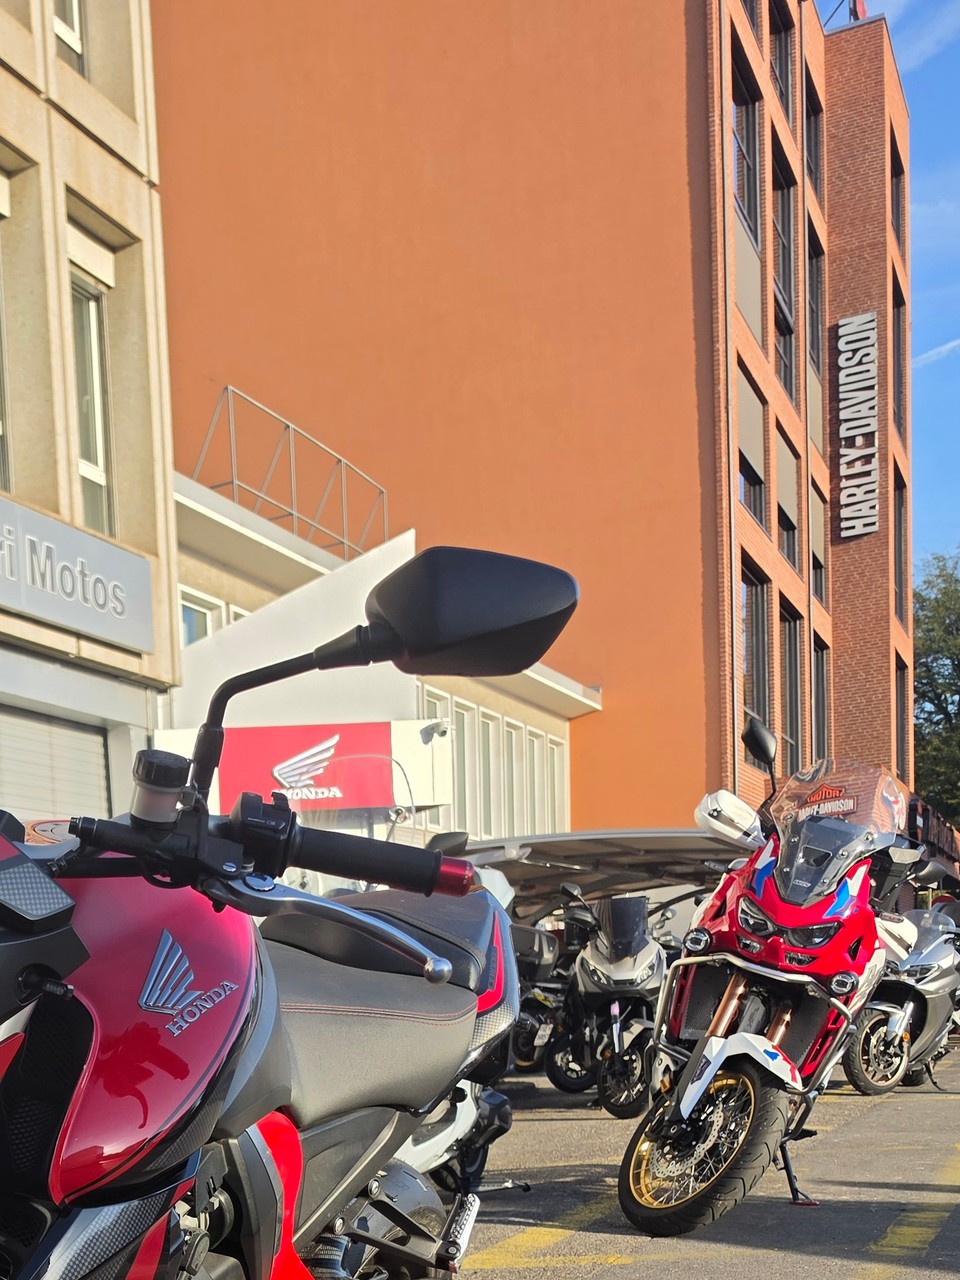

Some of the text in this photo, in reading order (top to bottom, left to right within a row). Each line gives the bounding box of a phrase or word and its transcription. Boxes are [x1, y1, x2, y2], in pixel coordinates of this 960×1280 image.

[838, 312, 879, 538] HARLEY-DAVIDSON
[25, 534, 127, 619] Motos
[165, 980, 239, 1037] HONDA
